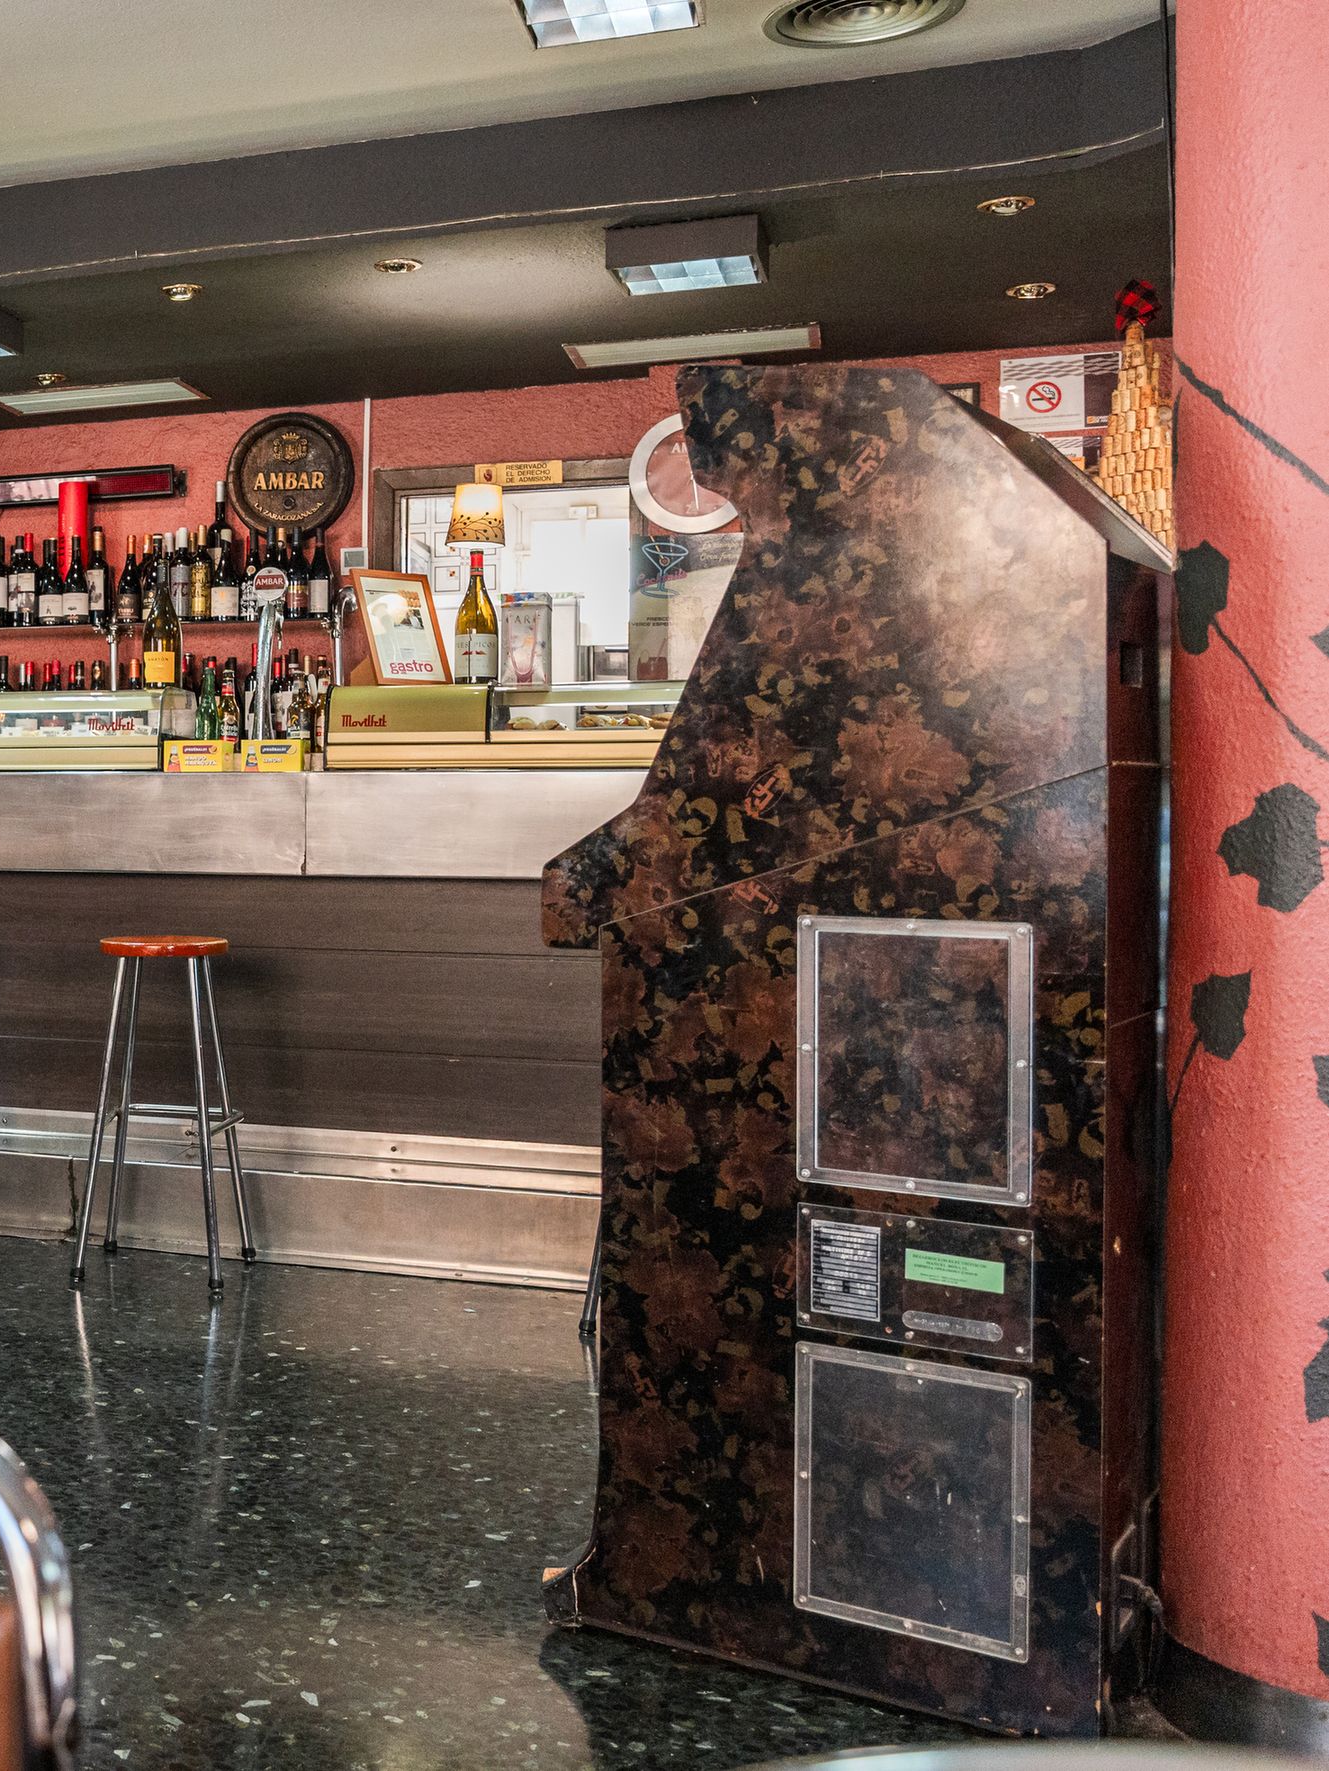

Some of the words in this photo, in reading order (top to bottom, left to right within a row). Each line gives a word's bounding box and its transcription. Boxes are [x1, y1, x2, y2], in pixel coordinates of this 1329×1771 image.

[253, 471, 325, 490] AMBAR
[254, 503, 263, 512] LA
[263, 510, 311, 521] ZARAGOZANA
[255, 578, 284, 586] AMBAR
[389, 659, 434, 675] gastro
